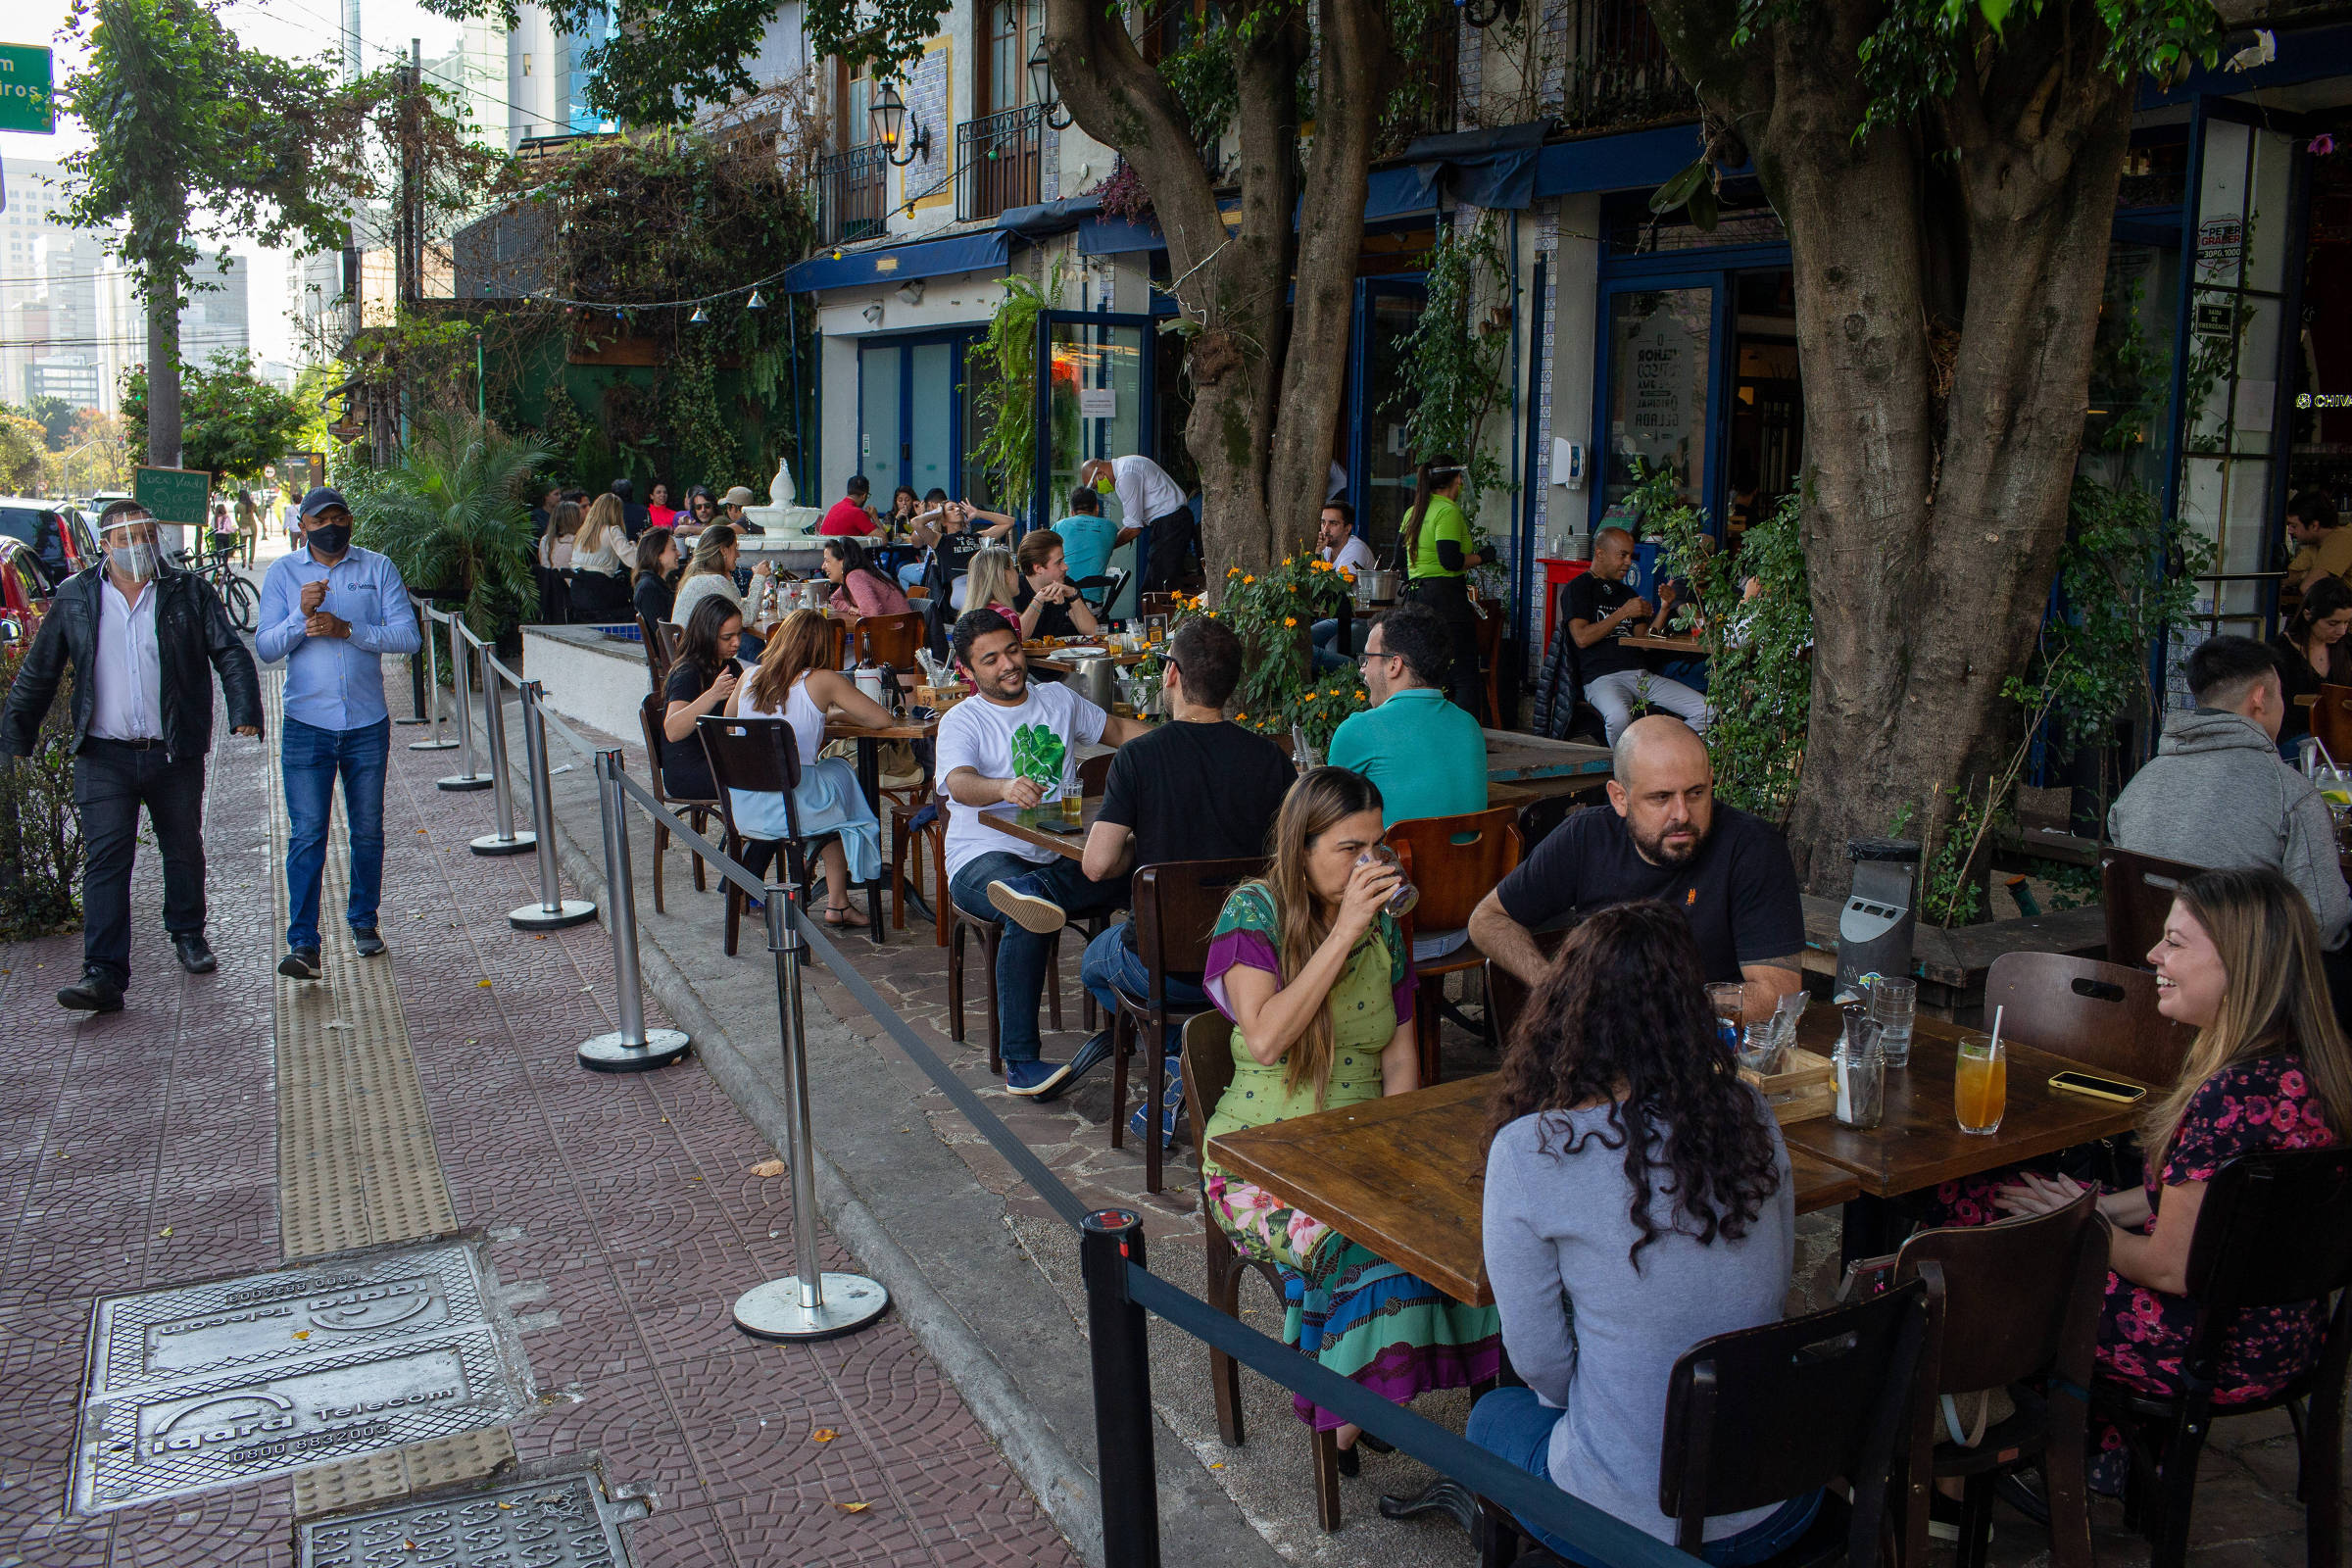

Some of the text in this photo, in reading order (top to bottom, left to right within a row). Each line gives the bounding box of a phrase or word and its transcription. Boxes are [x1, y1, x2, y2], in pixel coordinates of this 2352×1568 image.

[161, 1306, 293, 1335] Telecom
[313, 1388, 456, 1421] Telecom
[233, 1425, 387, 1462] 0800 8832003
